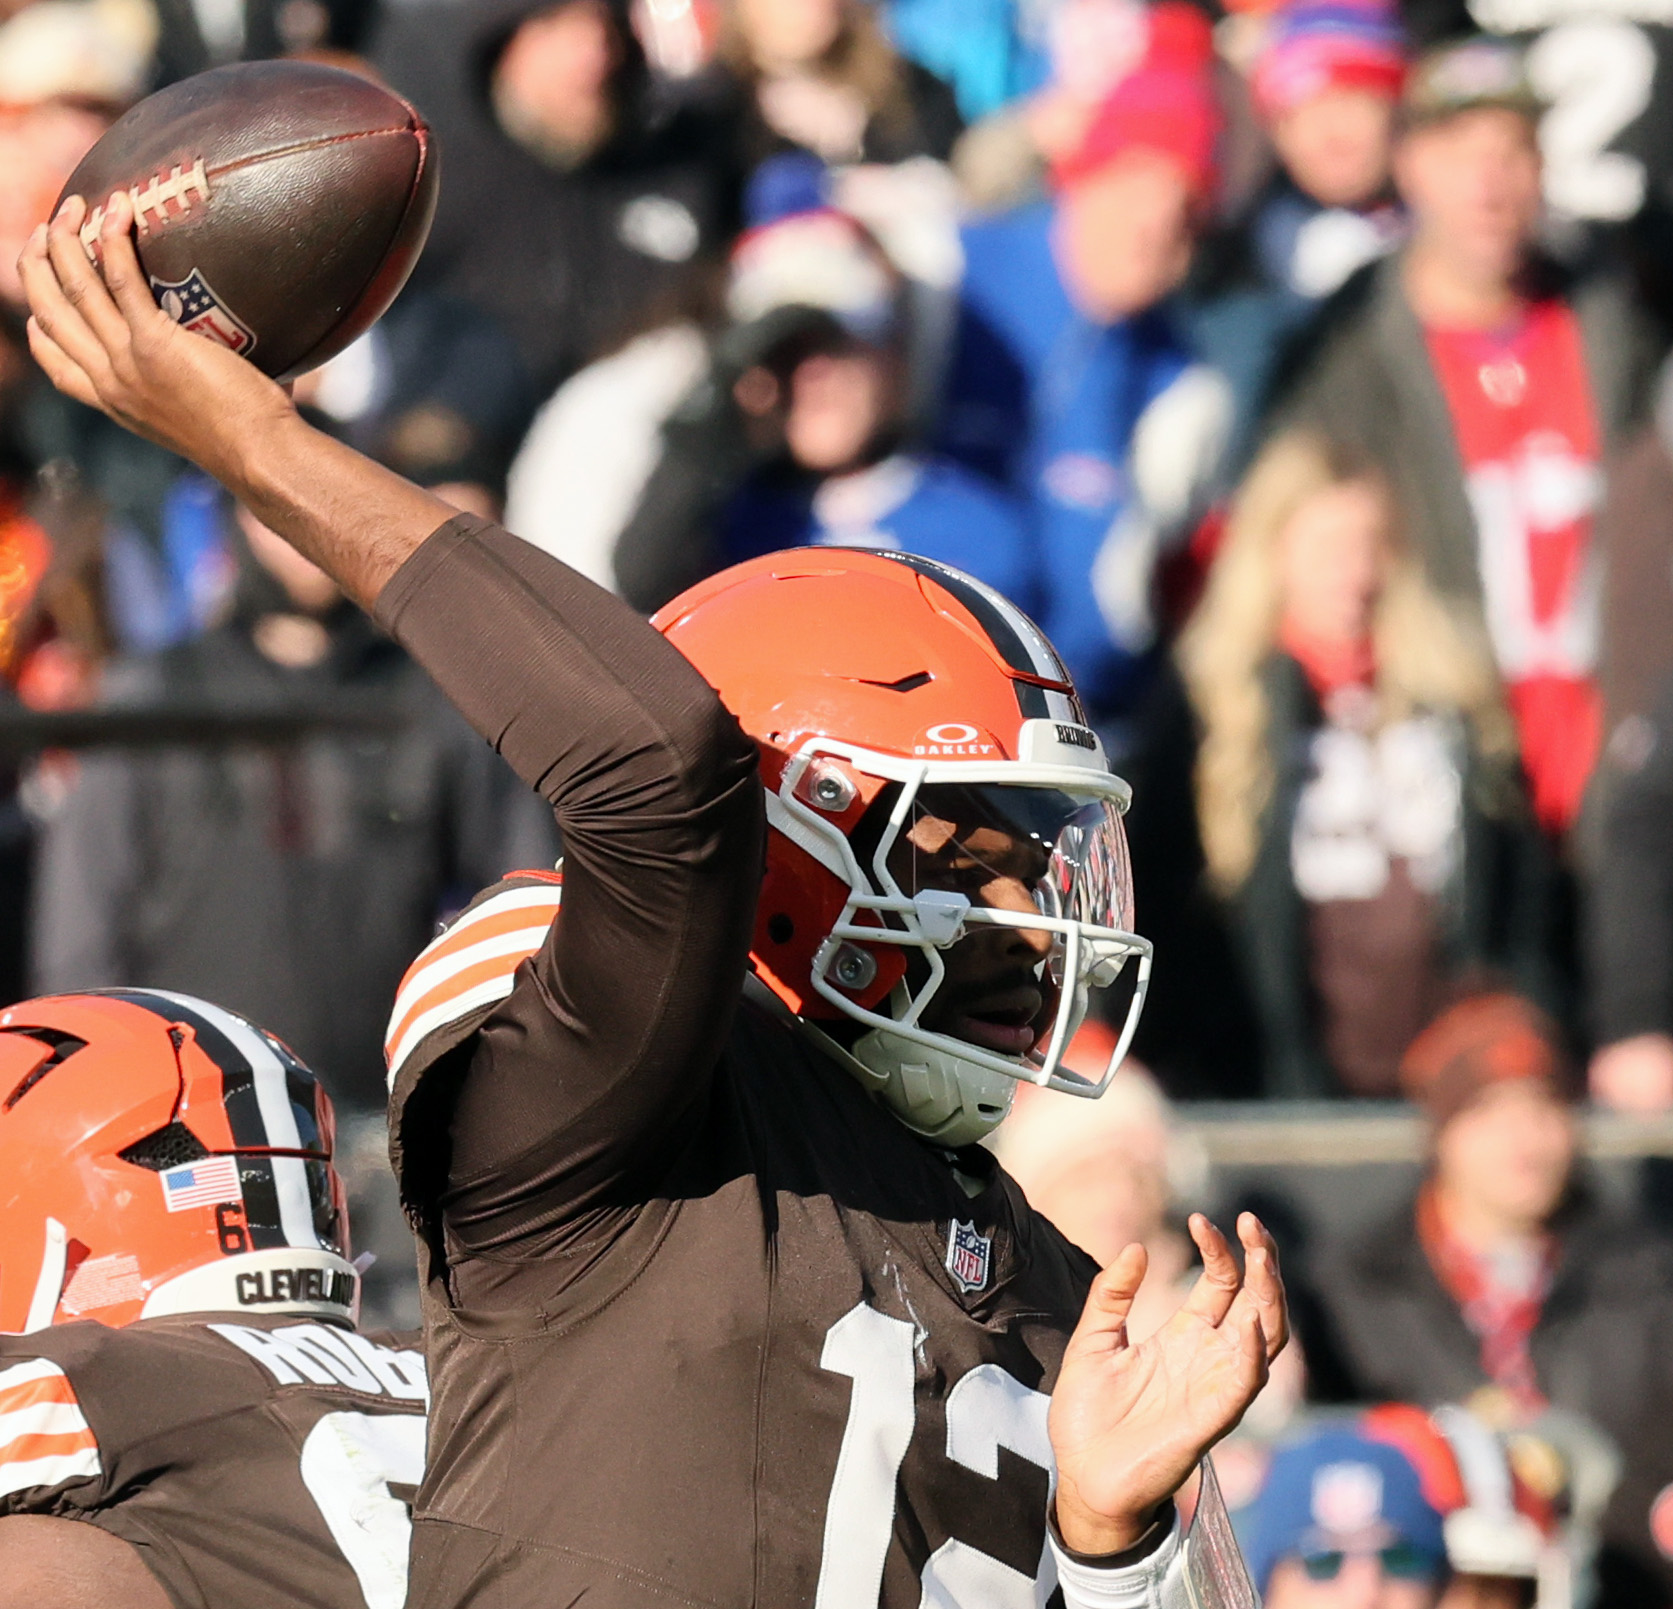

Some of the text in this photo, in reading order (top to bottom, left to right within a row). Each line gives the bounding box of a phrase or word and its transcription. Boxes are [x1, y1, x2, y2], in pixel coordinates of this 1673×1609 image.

[914, 744, 990, 755] OAKLEY
[216, 1203, 249, 1255] 6
[954, 1247, 982, 1282] NFL
